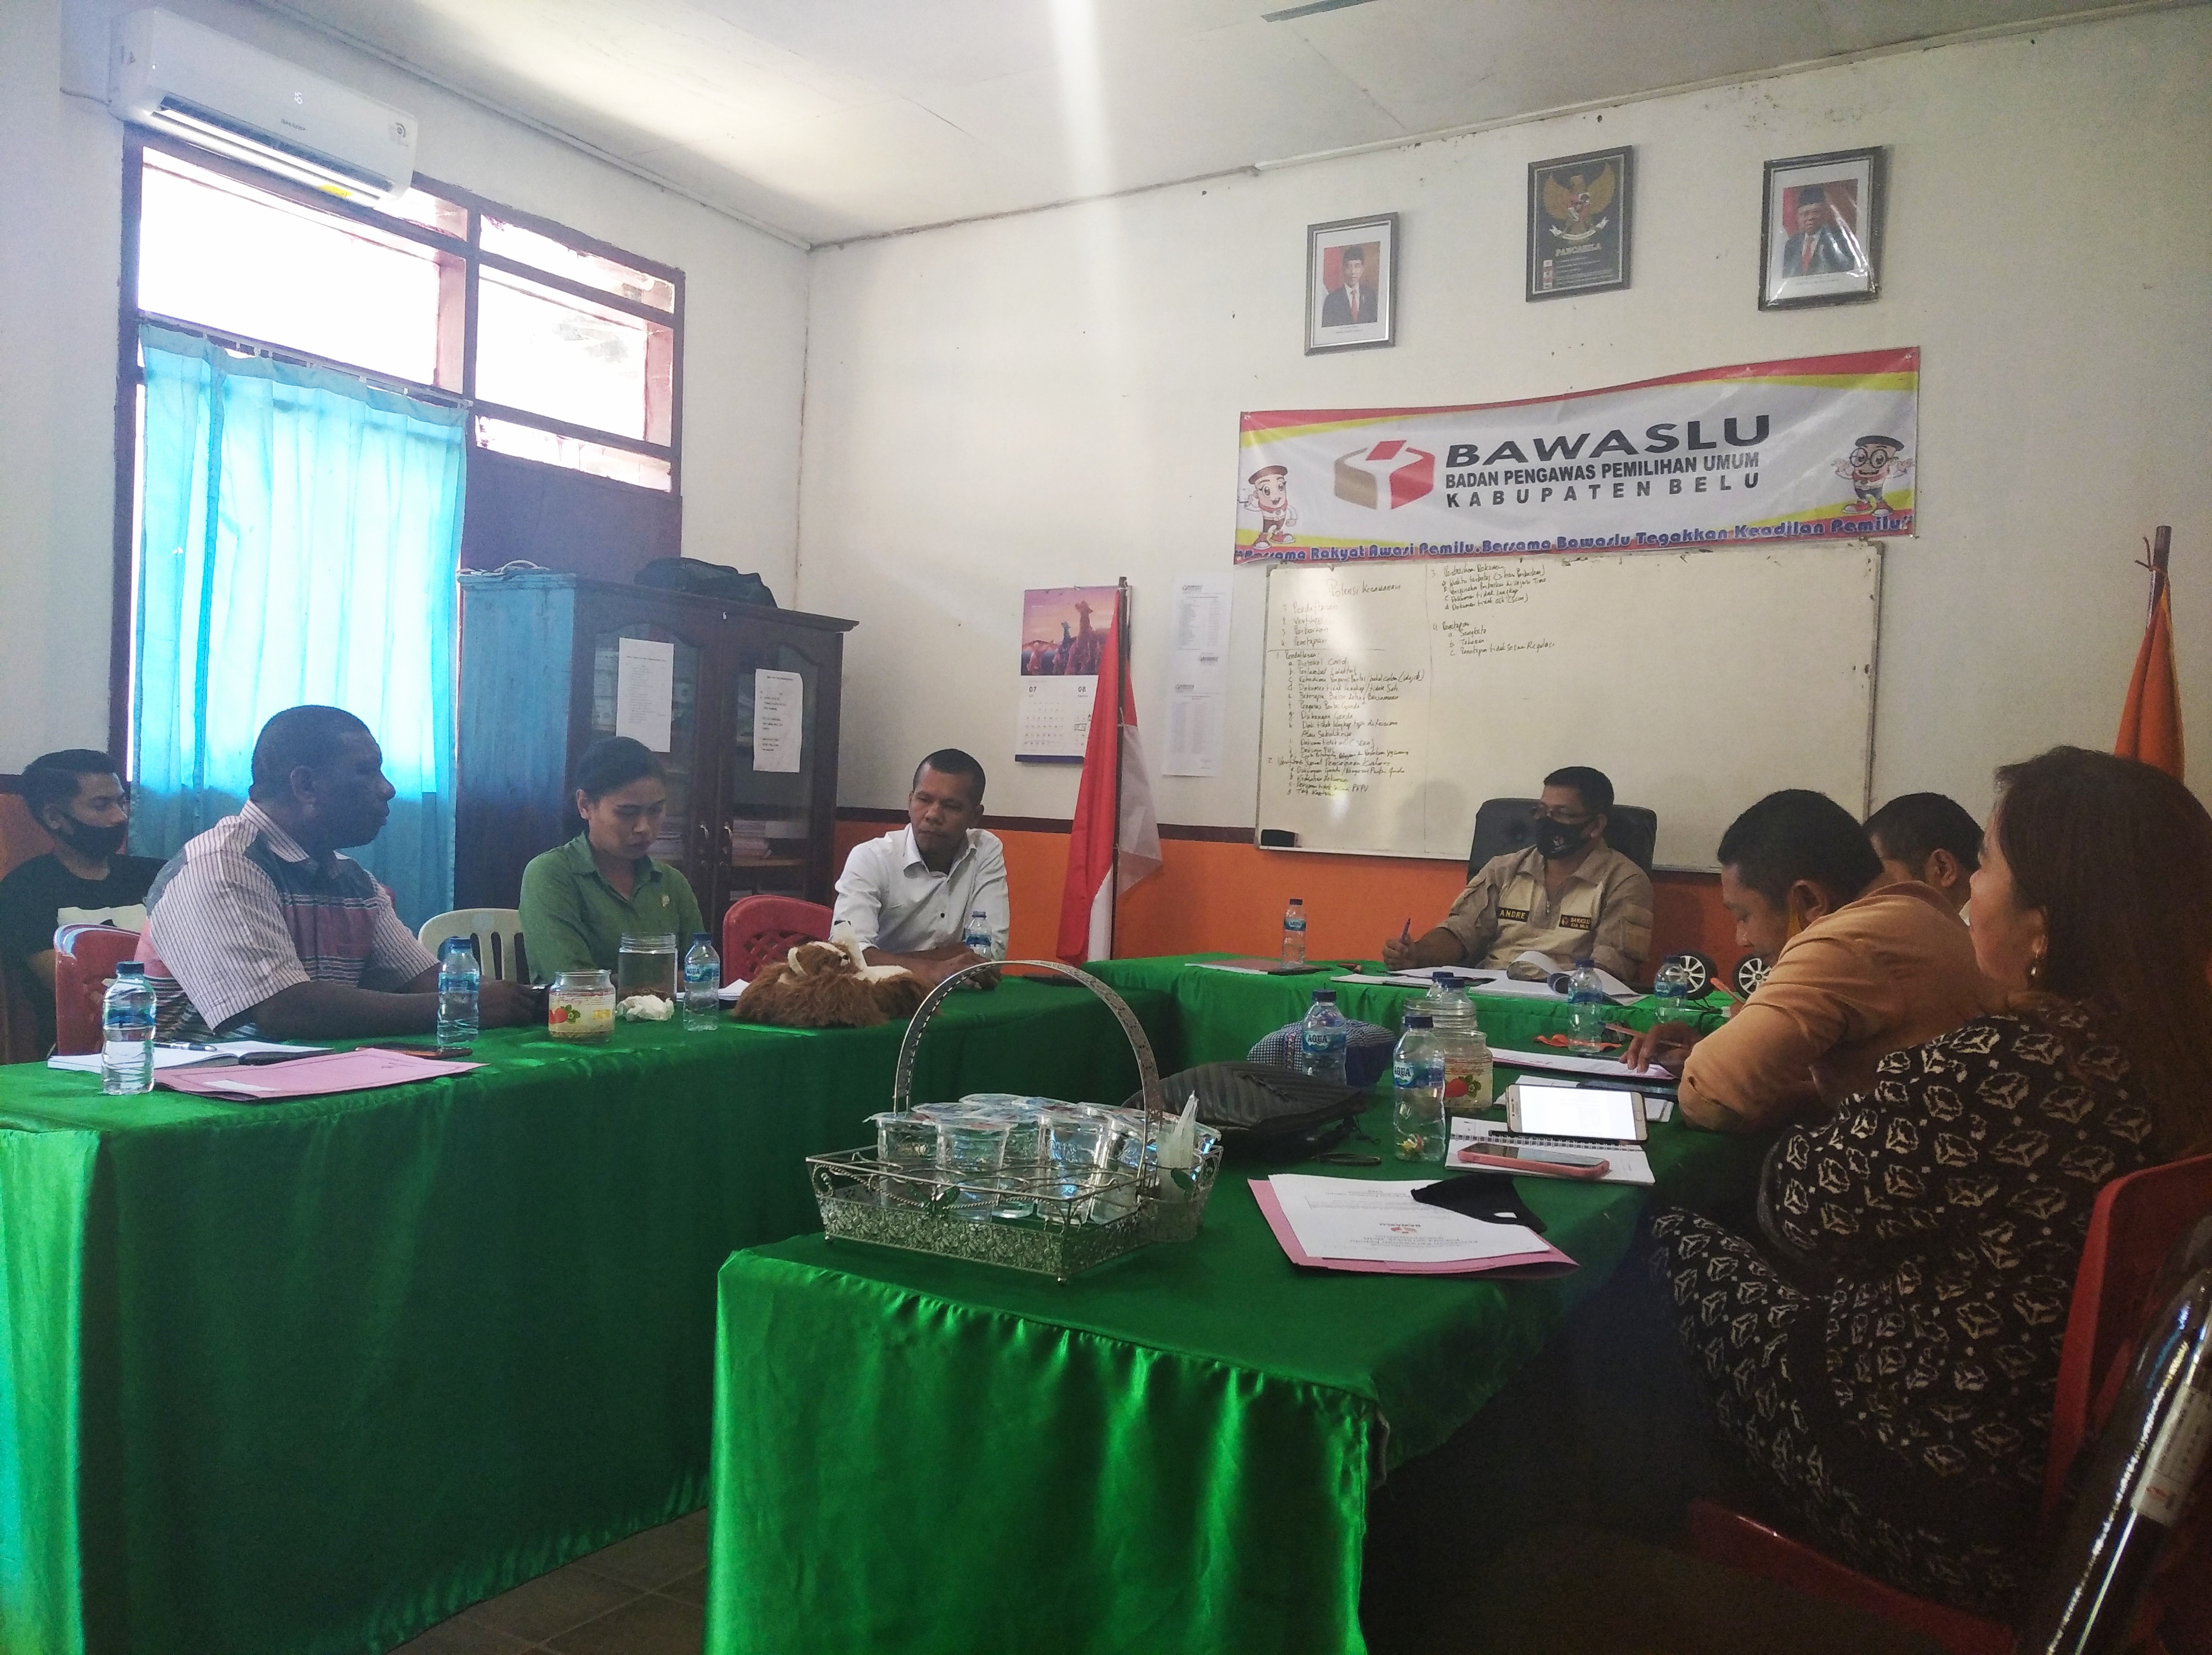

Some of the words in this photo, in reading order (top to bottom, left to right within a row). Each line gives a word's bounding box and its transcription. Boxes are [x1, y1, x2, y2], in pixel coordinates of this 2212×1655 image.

[1446, 415, 1770, 468] BAWASLU
[1446, 470, 1499, 488] BADAN
[1504, 464, 1596, 486] PENGAWAS
[1602, 457, 1697, 479] PEMILIHAN
[1704, 452, 1759, 472] UMUM
[1447, 480, 1651, 508] KABUPATEN
[1669, 472, 1759, 495] BELU
[1311, 545, 1365, 561] Rakyat
[1368, 543, 1415, 558] Awasi
[1556, 533, 1632, 549] Bawaslu
[1635, 528, 1729, 546] Tegakkan
[1734, 521, 1825, 538] Keadilan
[1327, 579, 1359, 597] Potensi
[1499, 909, 1526, 919] ANDRE
[1307, 1034, 1328, 1044] AQUA
[1393, 1066, 1411, 1077] AQUA
